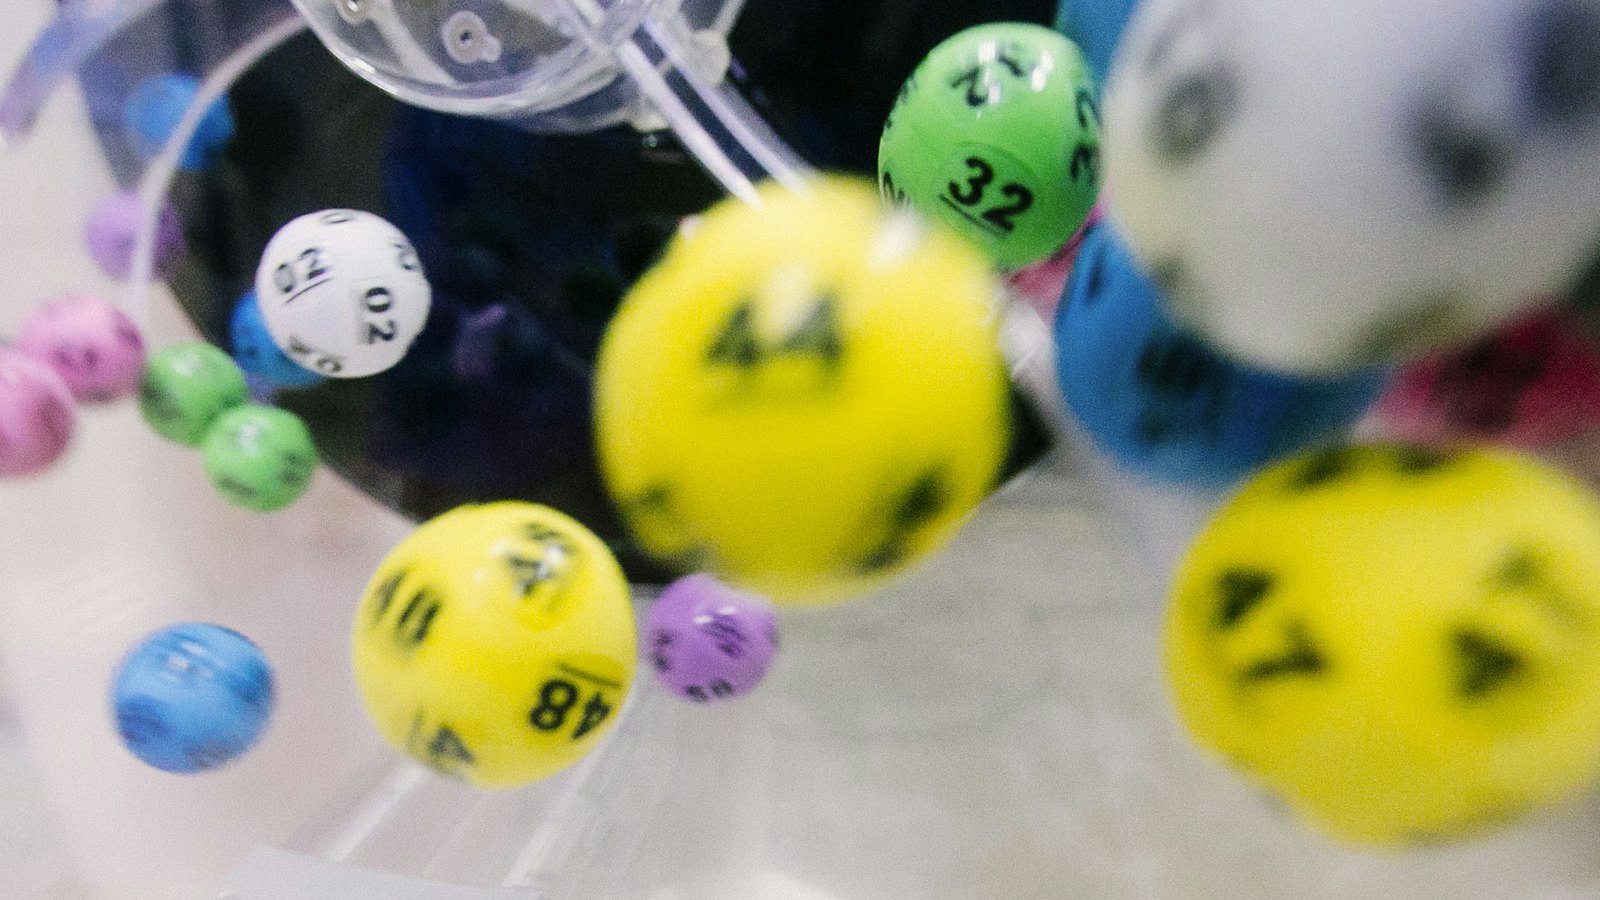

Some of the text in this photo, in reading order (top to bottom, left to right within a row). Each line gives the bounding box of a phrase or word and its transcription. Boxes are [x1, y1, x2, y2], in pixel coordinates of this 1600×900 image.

[948, 156, 1034, 233] 32
[360, 286, 398, 345] 02
[704, 290, 844, 369] 44
[528, 678, 612, 741] 48
